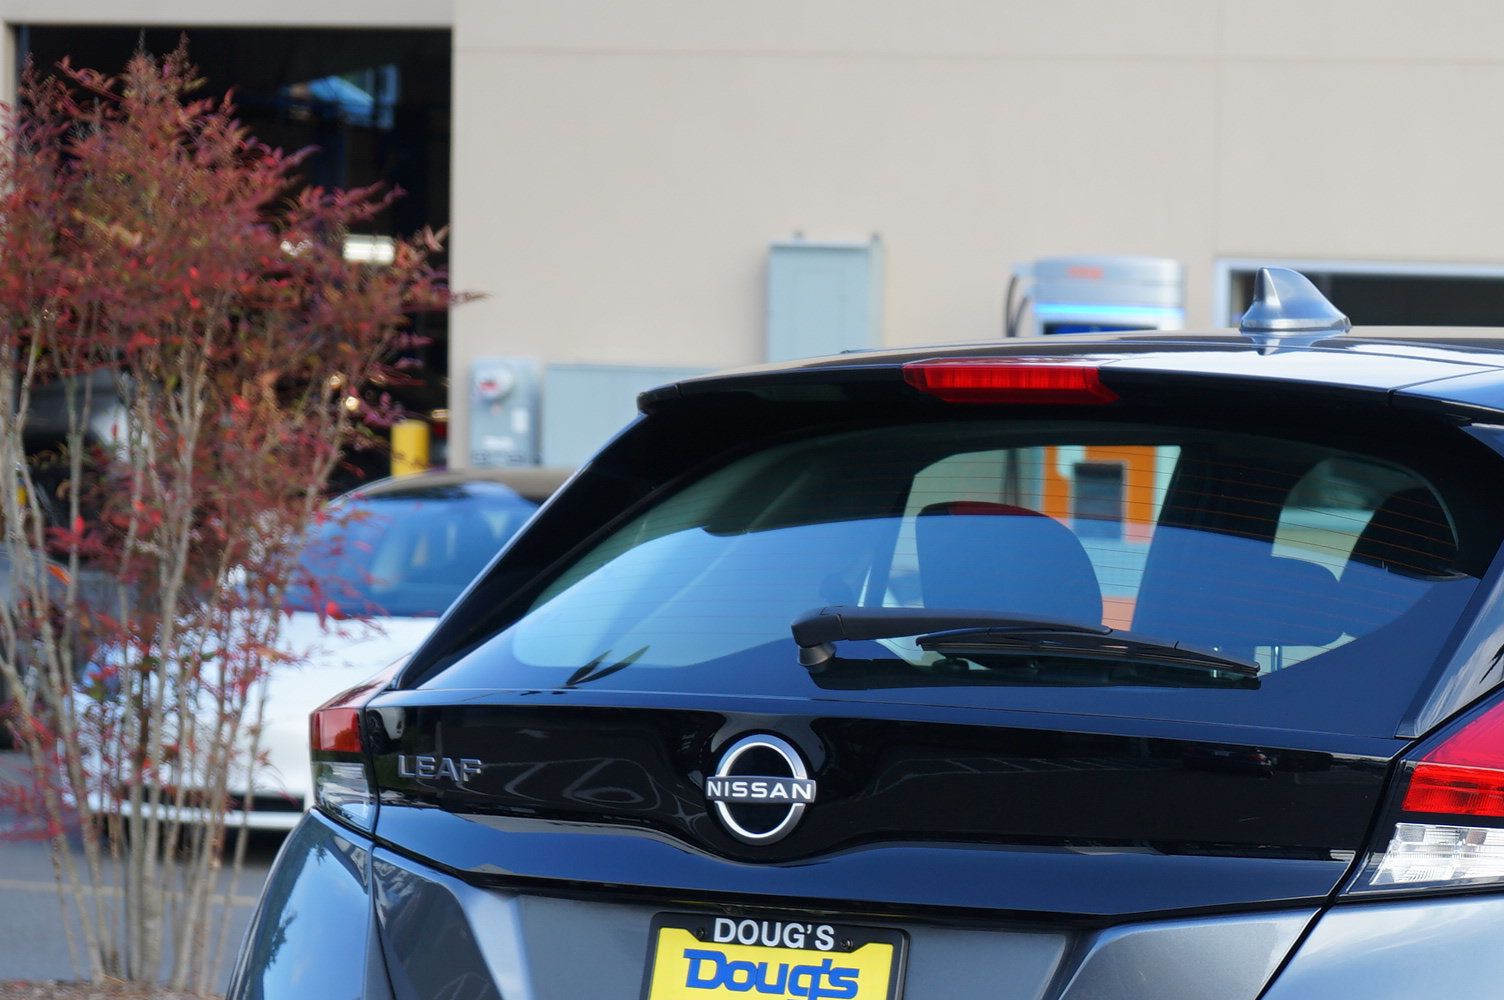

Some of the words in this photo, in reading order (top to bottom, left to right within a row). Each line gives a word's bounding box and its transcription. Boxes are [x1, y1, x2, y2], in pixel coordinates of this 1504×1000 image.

[398, 754, 482, 783] LEAF
[706, 777, 813, 800] NISSAN
[713, 917, 835, 951] DOUG'S
